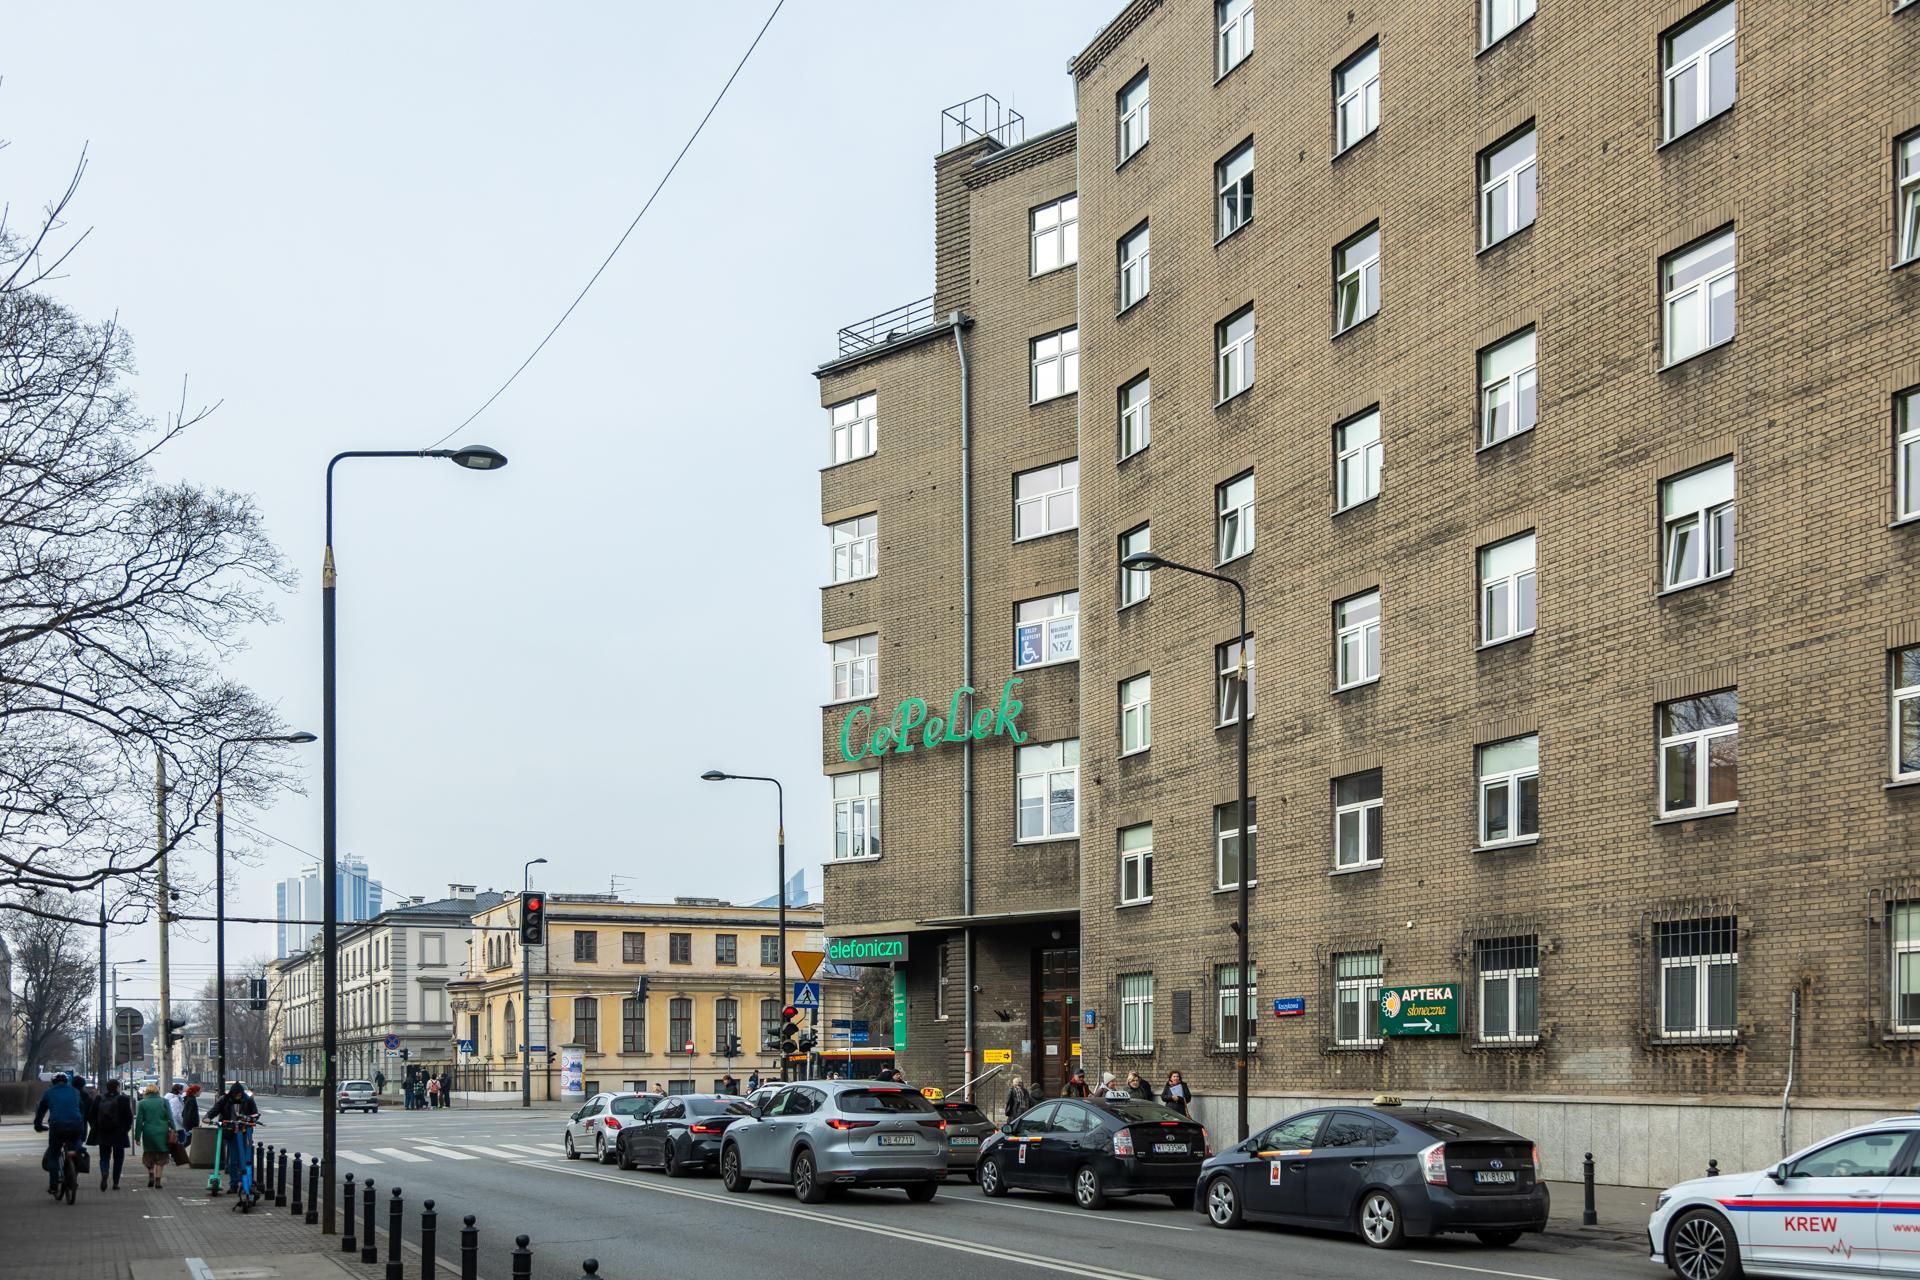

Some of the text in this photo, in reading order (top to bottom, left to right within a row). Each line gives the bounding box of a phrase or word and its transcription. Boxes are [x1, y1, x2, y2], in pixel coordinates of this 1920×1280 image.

[1052, 639, 1073, 652] NFZ
[841, 678, 1028, 761] CePeLek
[830, 939, 902, 958] elefoniczn
[1402, 987, 1453, 1001] APTEKA
[1407, 1002, 1447, 1017] słoneczna
[1383, 1096, 1401, 1104] TAXI
[1784, 1216, 1838, 1232] KREW
